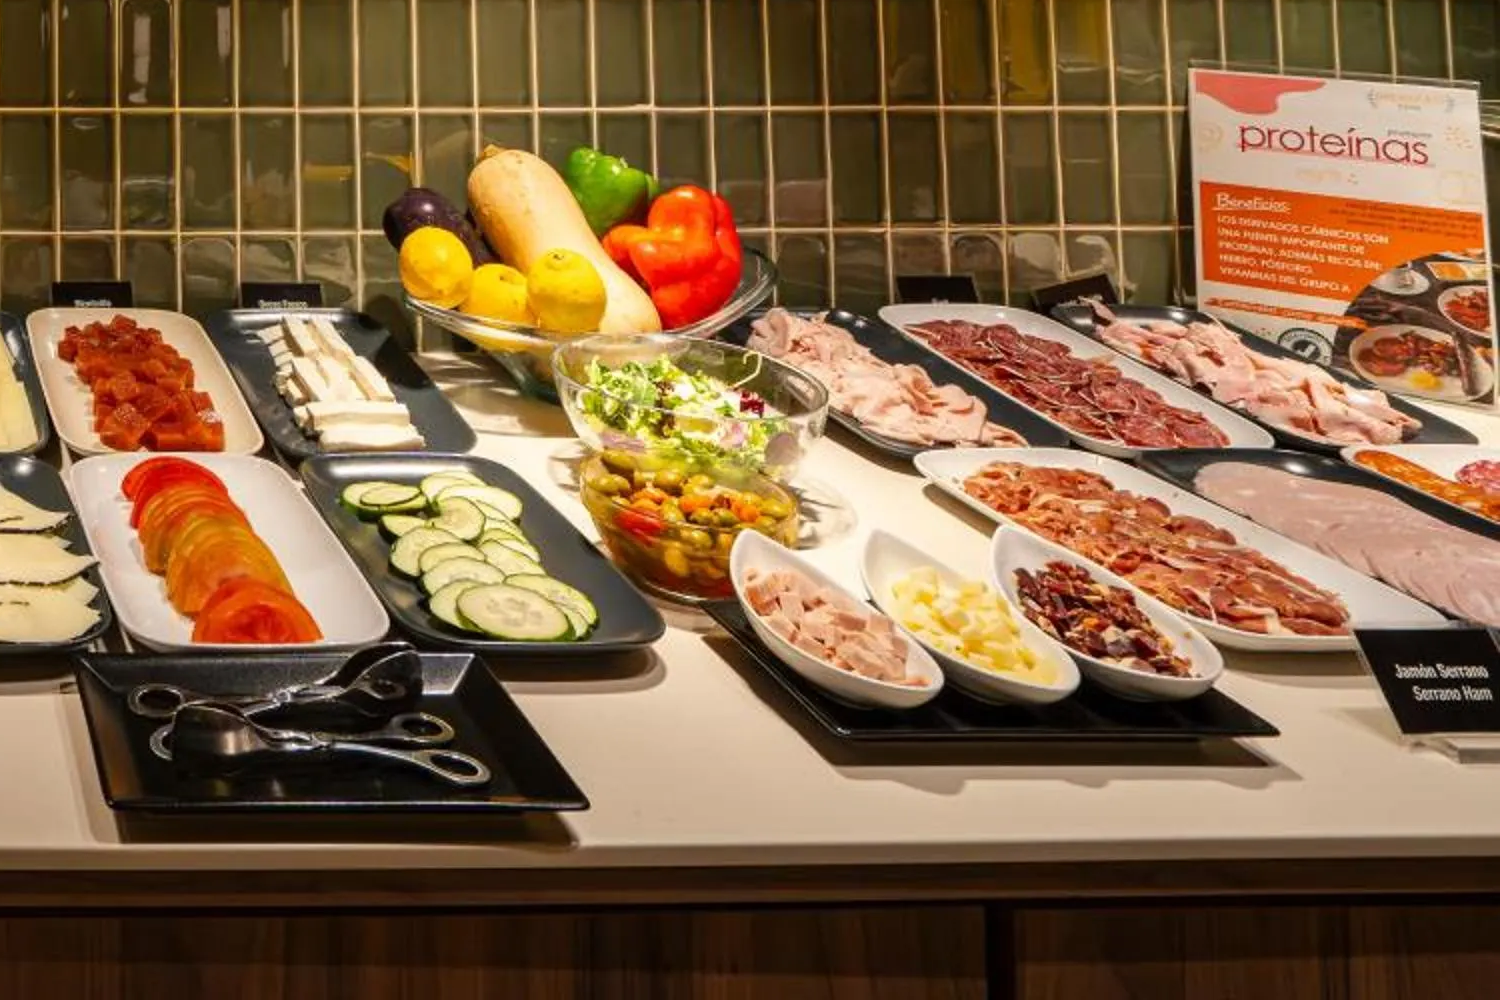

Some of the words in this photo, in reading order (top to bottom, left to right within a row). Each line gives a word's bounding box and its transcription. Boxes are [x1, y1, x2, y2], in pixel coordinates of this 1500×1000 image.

[1238, 125, 1429, 166] proteínas
[1217, 214, 1237, 225] LOS
[1239, 217, 1300, 233] DERIVADOS
[1364, 232, 1390, 245] SON
[1217, 228, 1241, 238] UNA
[1281, 235, 1349, 253] IMPORTANTE
[1349, 245, 1365, 256] DE
[1327, 255, 1363, 269] RICOS
[1219, 266, 1277, 283] VITAMINAS
[1278, 275, 1297, 286] DEL
[1299, 278, 1340, 292] GRUPO
[1395, 663, 1437, 679] Jamón
[1436, 663, 1489, 679] Serrano
[1412, 685, 1461, 701] Serrano
[1461, 685, 1493, 701] Ham
